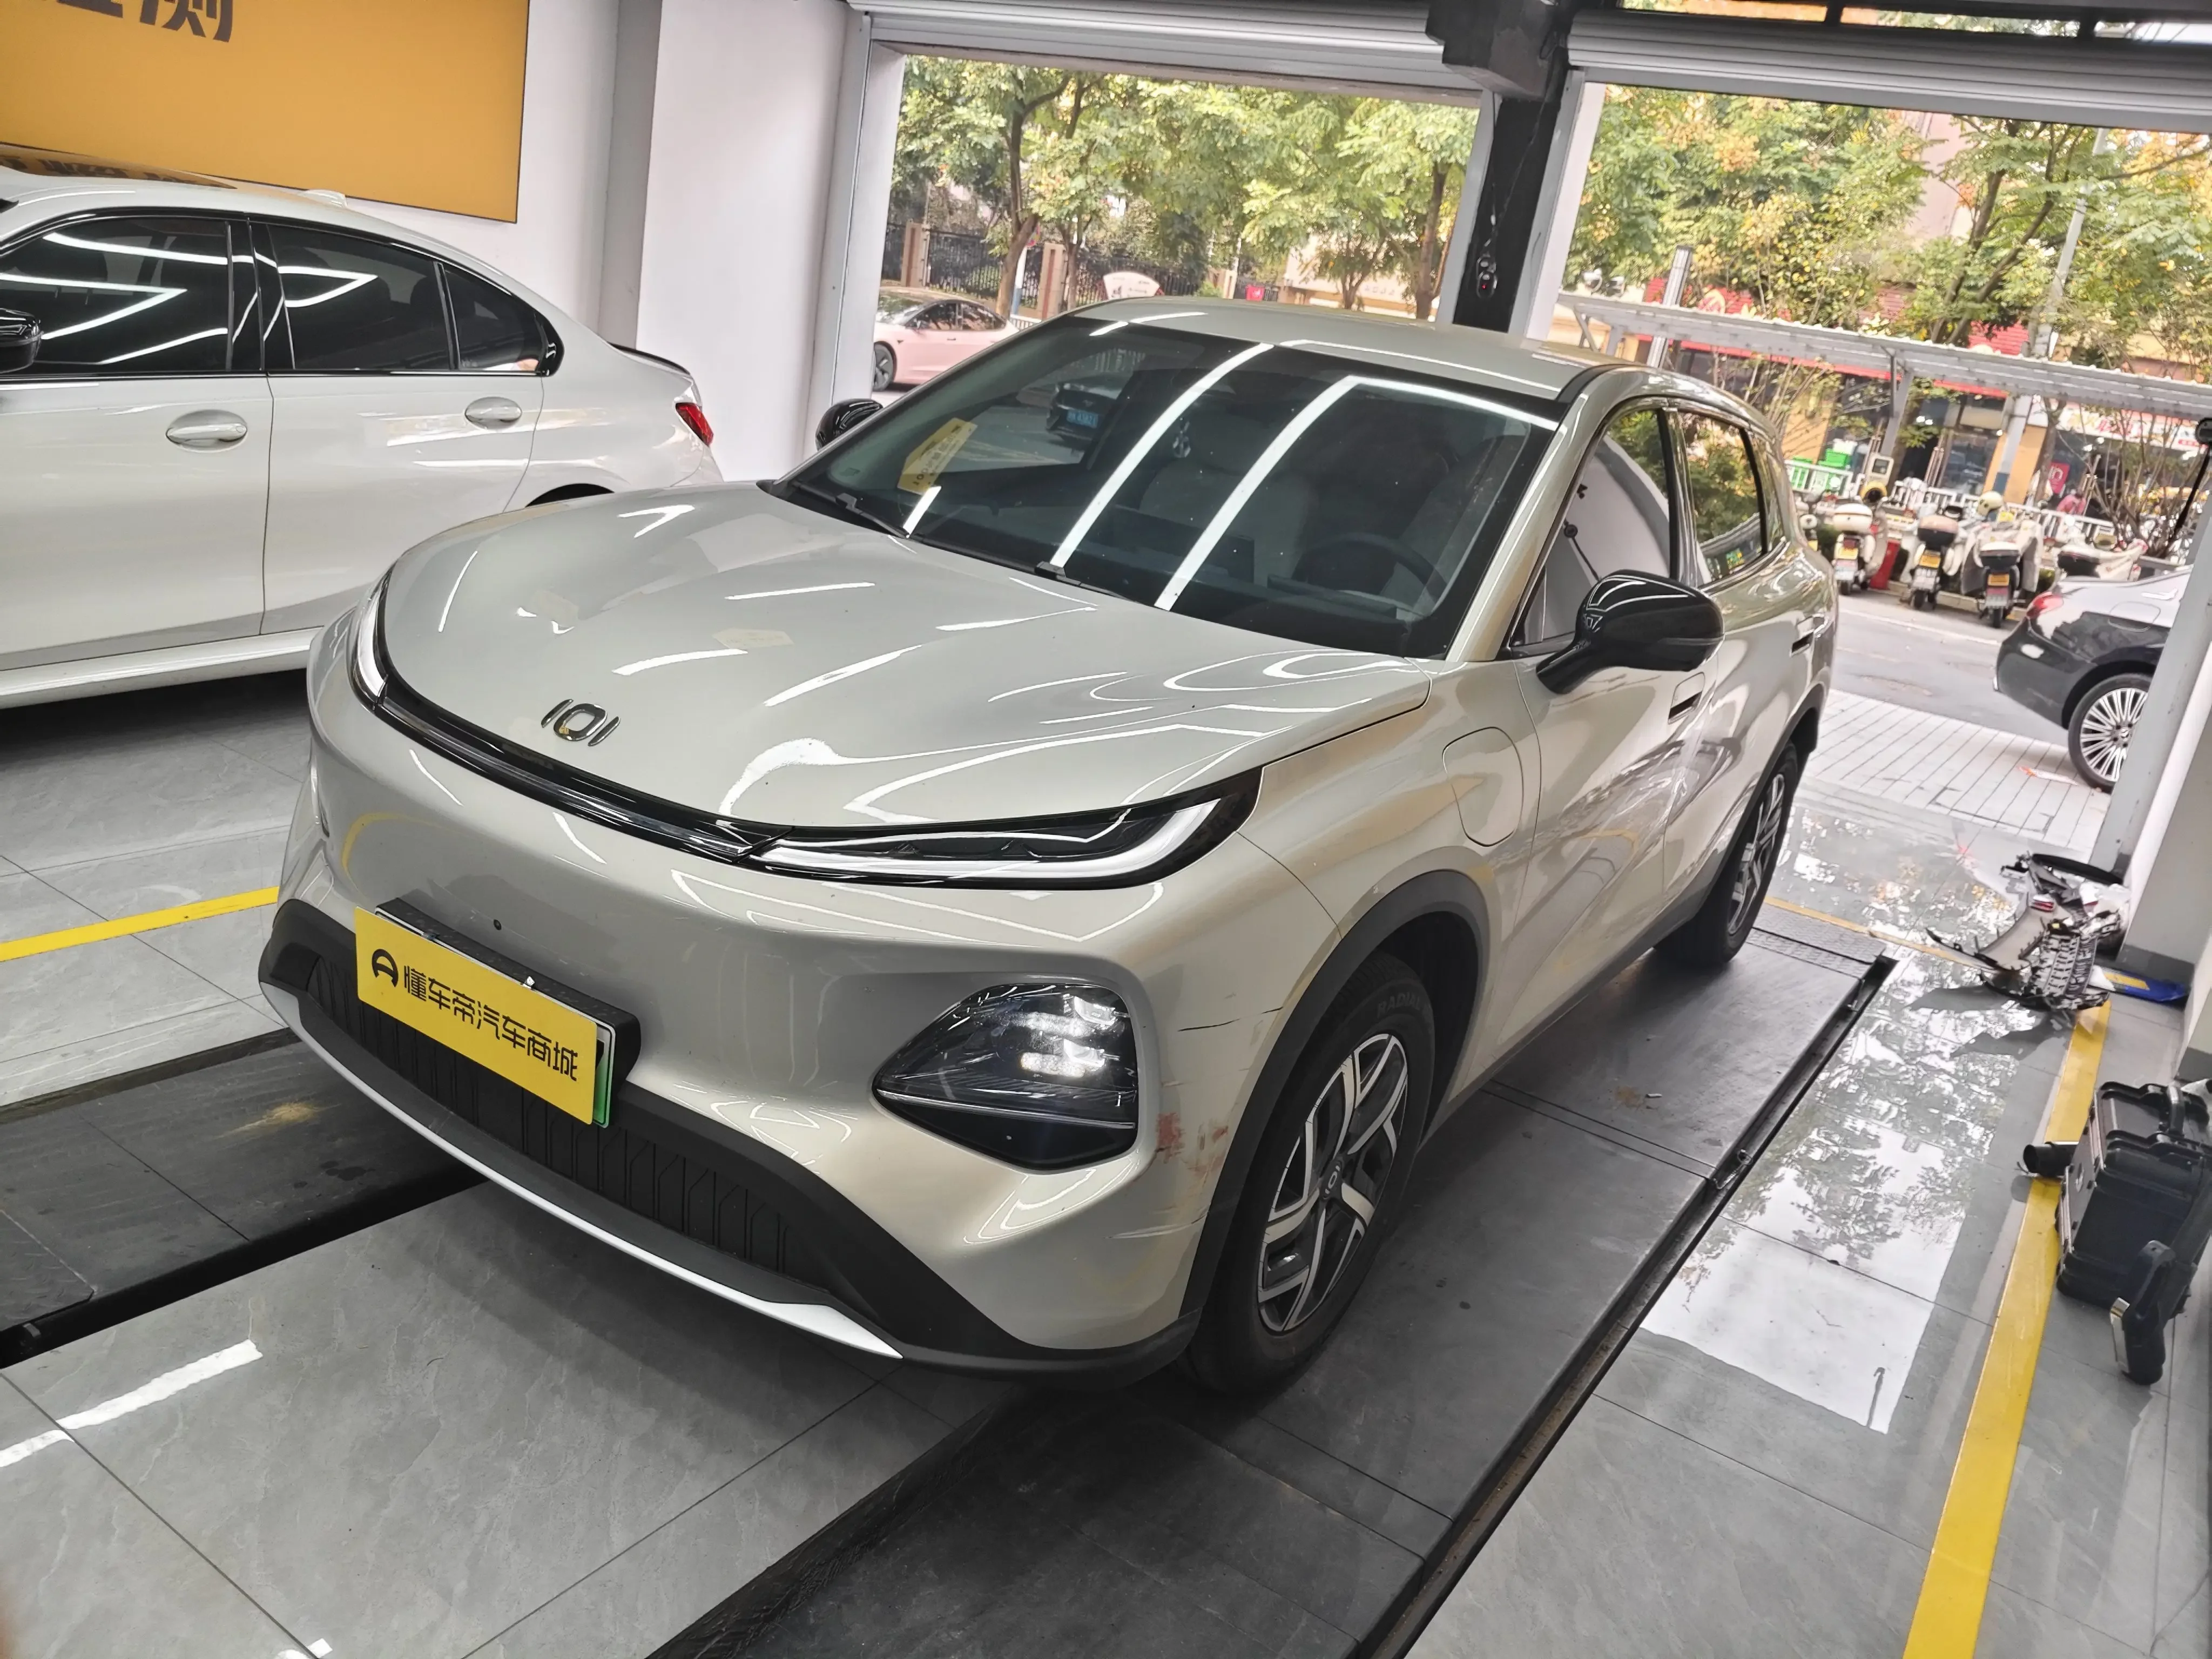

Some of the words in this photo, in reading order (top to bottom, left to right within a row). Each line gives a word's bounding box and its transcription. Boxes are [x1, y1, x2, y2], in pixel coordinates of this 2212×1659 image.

[403, 965, 578, 1082] 懂车帝汽车商城
